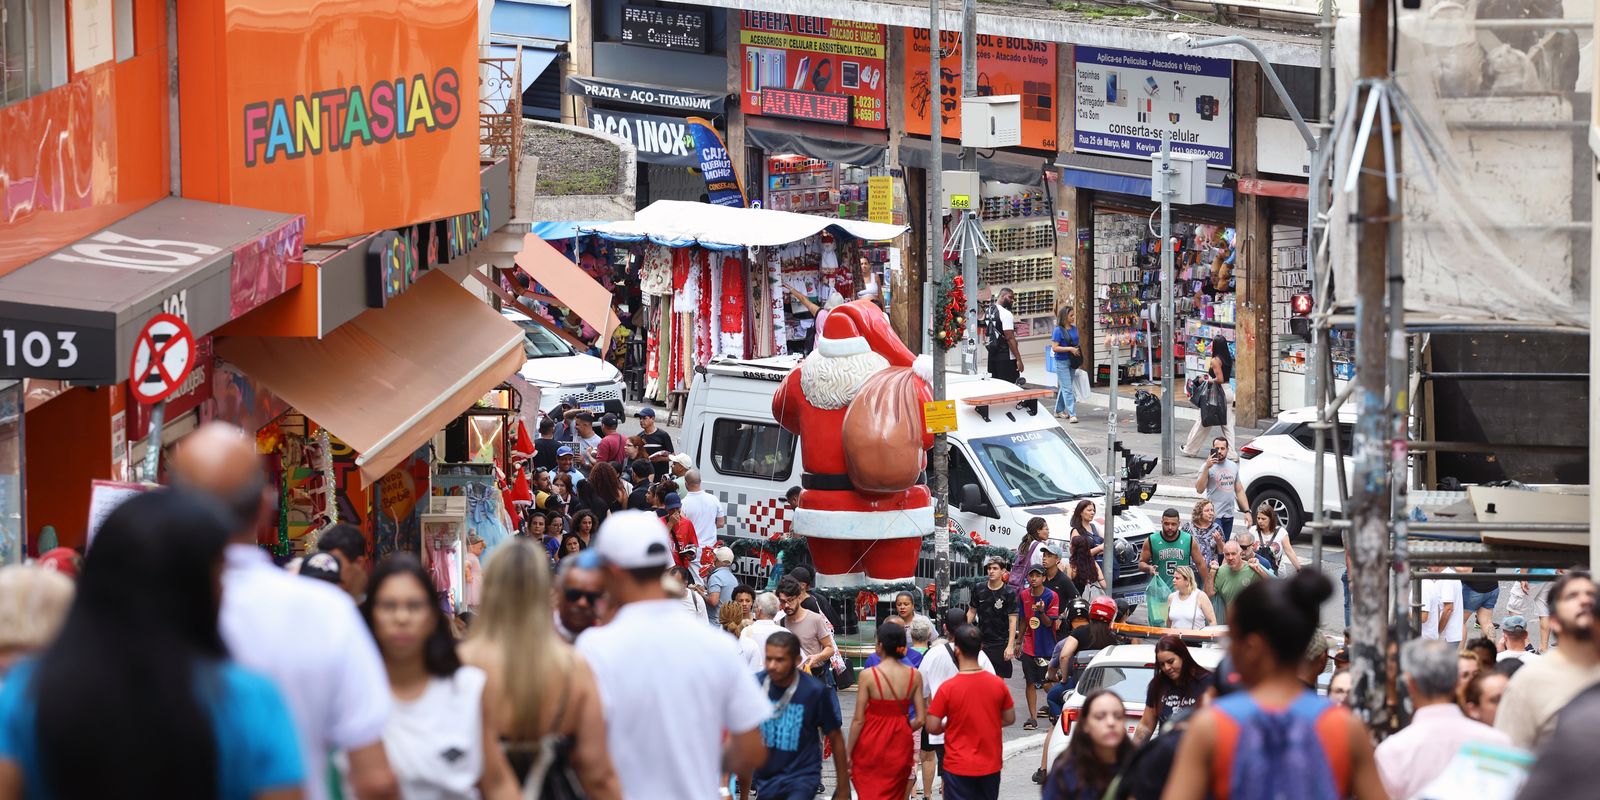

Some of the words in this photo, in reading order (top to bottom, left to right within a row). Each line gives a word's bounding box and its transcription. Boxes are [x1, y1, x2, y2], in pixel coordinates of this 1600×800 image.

[625, 8, 663, 24] PRATA
[667, 15, 673, 24] e
[676, 14, 702, 31] AÇO
[796, 15, 827, 36] CELL
[647, 28, 700, 47] Conjuntos
[829, 28, 854, 40] ATACADO
[855, 31, 859, 41] E
[860, 32, 881, 43] VAREJO
[789, 39, 813, 50] CELULAR
[814, 41, 818, 50] E
[818, 42, 853, 54] ASSISTÊNCIA
[997, 38, 1003, 48] e
[1006, 37, 1048, 52] BOLSAS
[913, 42, 931, 53] Óculo
[996, 52, 1021, 62] Atacado
[1028, 55, 1049, 67] Varejo
[1097, 52, 1122, 65] Aplica-se
[1152, 59, 1178, 70] Atacados
[1183, 61, 1202, 73] Varejo
[584, 85, 621, 99] PRATA
[789, 93, 813, 119] NA
[244, 67, 461, 168] FANTASIAS
[1089, 111, 1100, 121] Som
[636, 119, 689, 157] INOX
[1042, 138, 1055, 148] 644
[1078, 134, 1089, 144] Rua
[1089, 135, 1096, 144] 25
[1096, 137, 1103, 145] de
[1121, 140, 1131, 150] 640
[1136, 142, 1156, 152] Kevin
[951, 199, 969, 207] 4648
[3, 329, 78, 368] 103
[743, 371, 765, 379] BASE
[1010, 432, 1042, 443] POLÍCIA
[997, 526, 1011, 536] 190
[1113, 523, 1140, 534] OLÍCIA
[1165, 560, 1177, 577] 5
